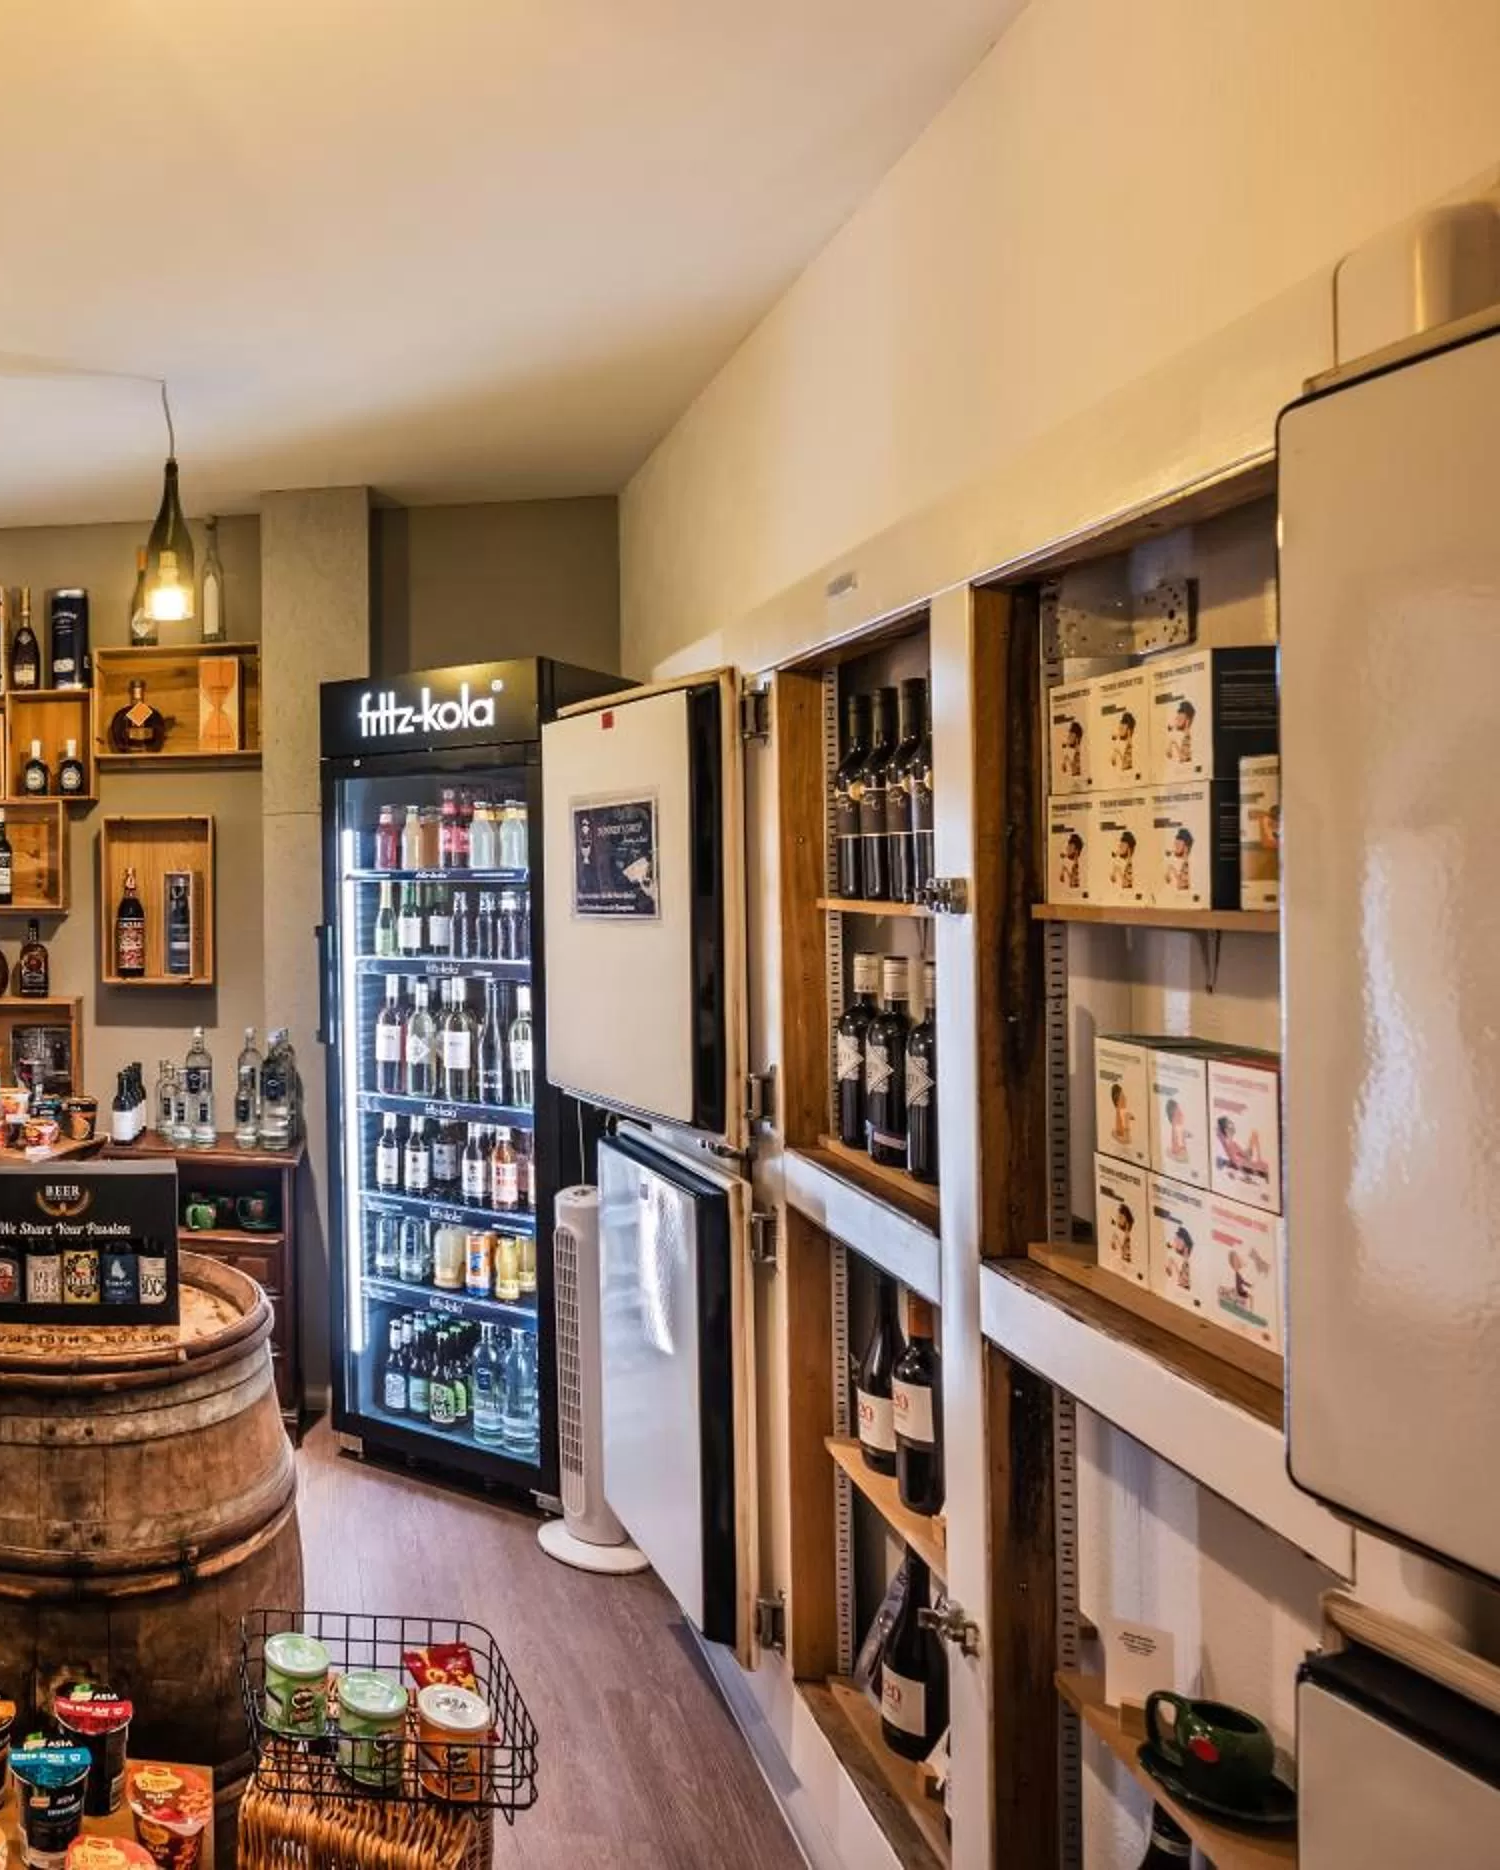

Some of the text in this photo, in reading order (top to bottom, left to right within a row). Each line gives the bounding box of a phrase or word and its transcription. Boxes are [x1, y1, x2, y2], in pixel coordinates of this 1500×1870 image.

[357, 680, 498, 738] fritz-kola
[45, 1185, 80, 1197] BEER
[19, 1221, 53, 1236] Share
[55, 1221, 85, 1236] Your
[86, 1221, 131, 1236] Passion
[94, 1692, 119, 1701] ASIA
[47, 1740, 73, 1748] ASIA
